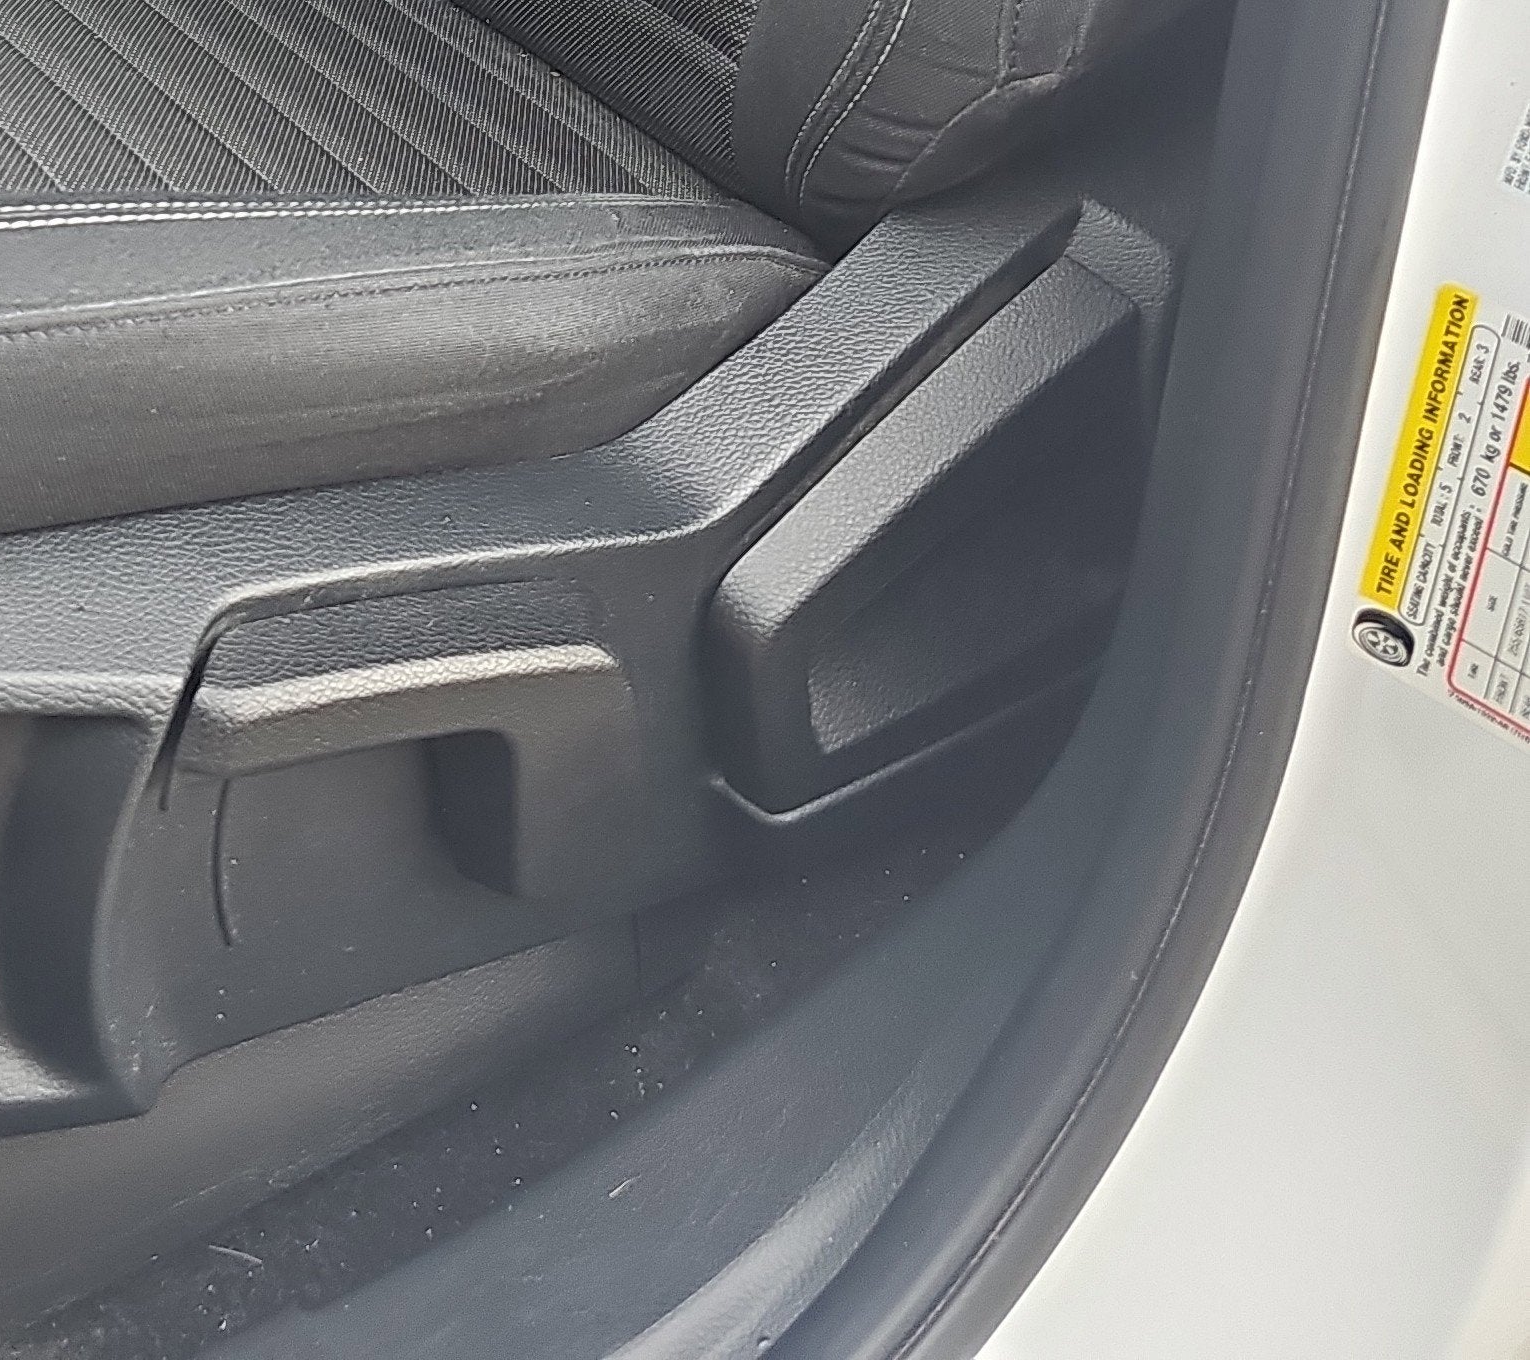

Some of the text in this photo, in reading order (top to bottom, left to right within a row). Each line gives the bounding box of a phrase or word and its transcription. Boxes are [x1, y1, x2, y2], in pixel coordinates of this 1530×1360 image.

[1475, 342, 1490, 355] 3
[1458, 411, 1471, 424] 2
[1470, 360, 1520, 498] 670 kg or 1479 lbs.
[1375, 293, 1470, 595] TIRE AND LOADING INFORMATION
[1439, 481, 1452, 494] 5
[1437, 573, 1454, 608] weight
[1447, 560, 1456, 574] of
[1436, 646, 1448, 668] and
